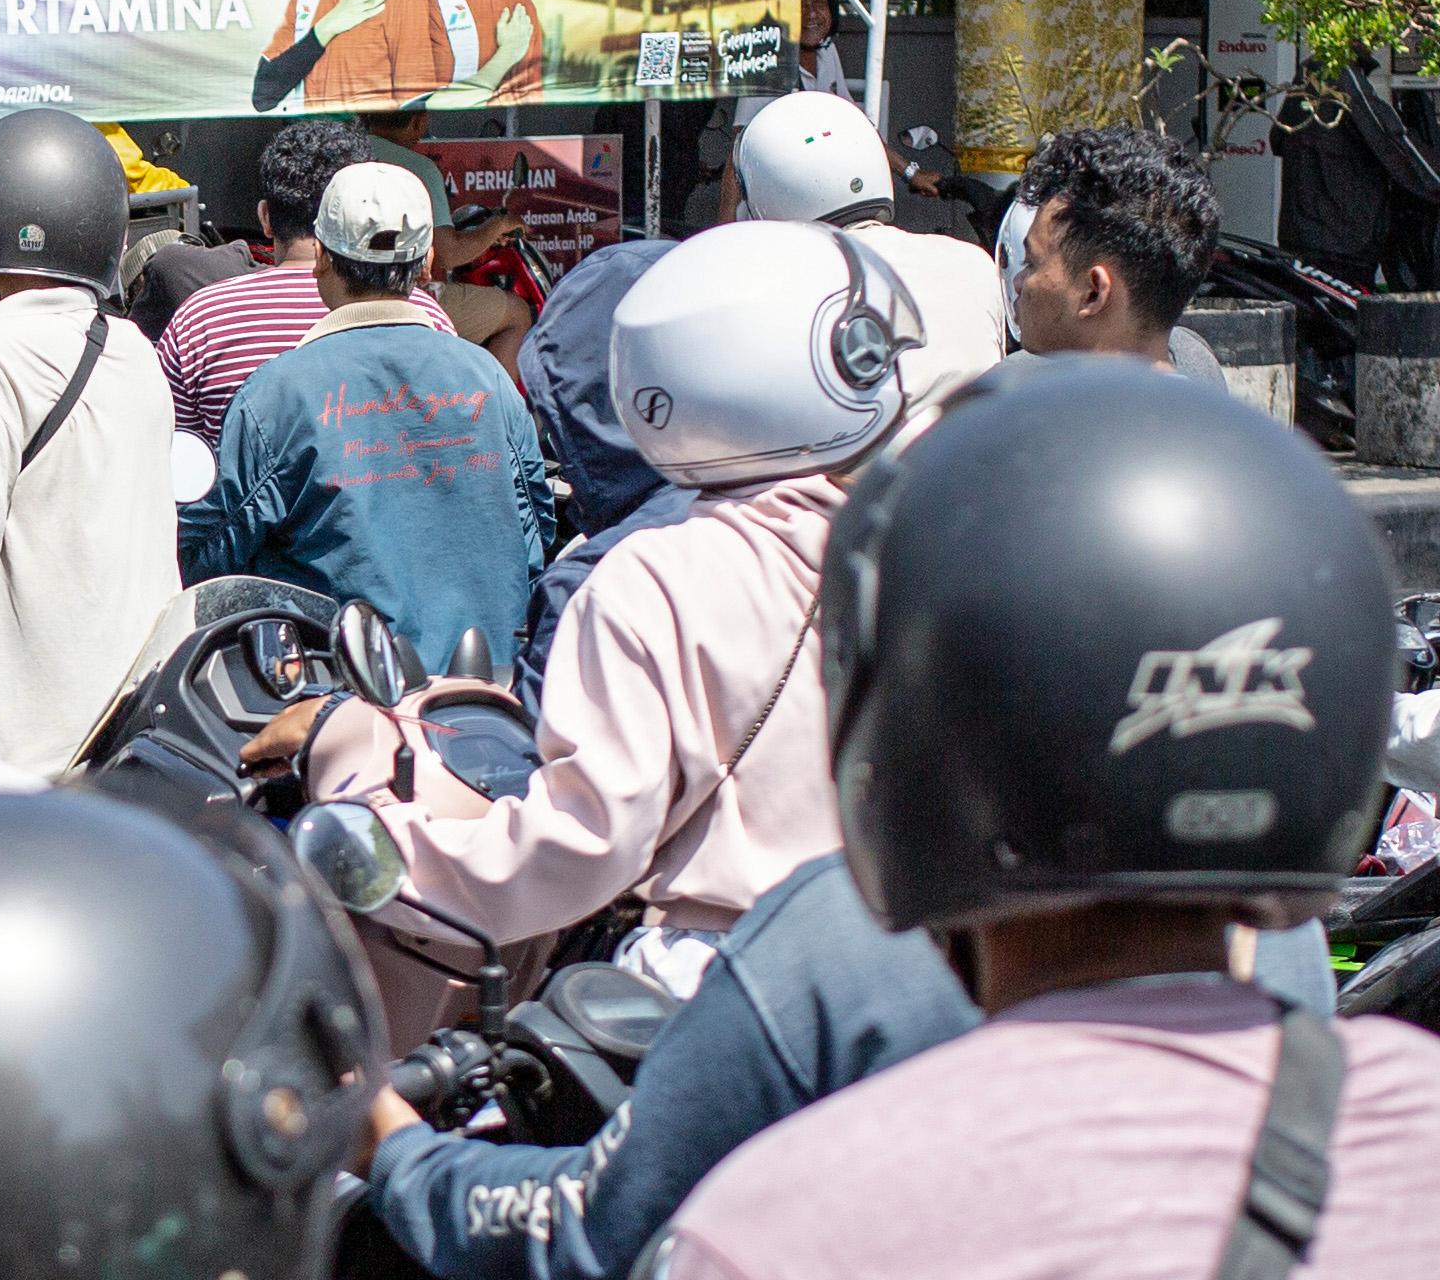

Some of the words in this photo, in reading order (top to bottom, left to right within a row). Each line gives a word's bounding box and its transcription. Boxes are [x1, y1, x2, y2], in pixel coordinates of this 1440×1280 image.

[718, 25, 781, 57] Energizing
[722, 52, 778, 84] Indonesia
[464, 169, 556, 191] PERHAIAN
[566, 209, 597, 222] Anda
[578, 234, 595, 250] HP
[464, 452, 501, 472] 1942
